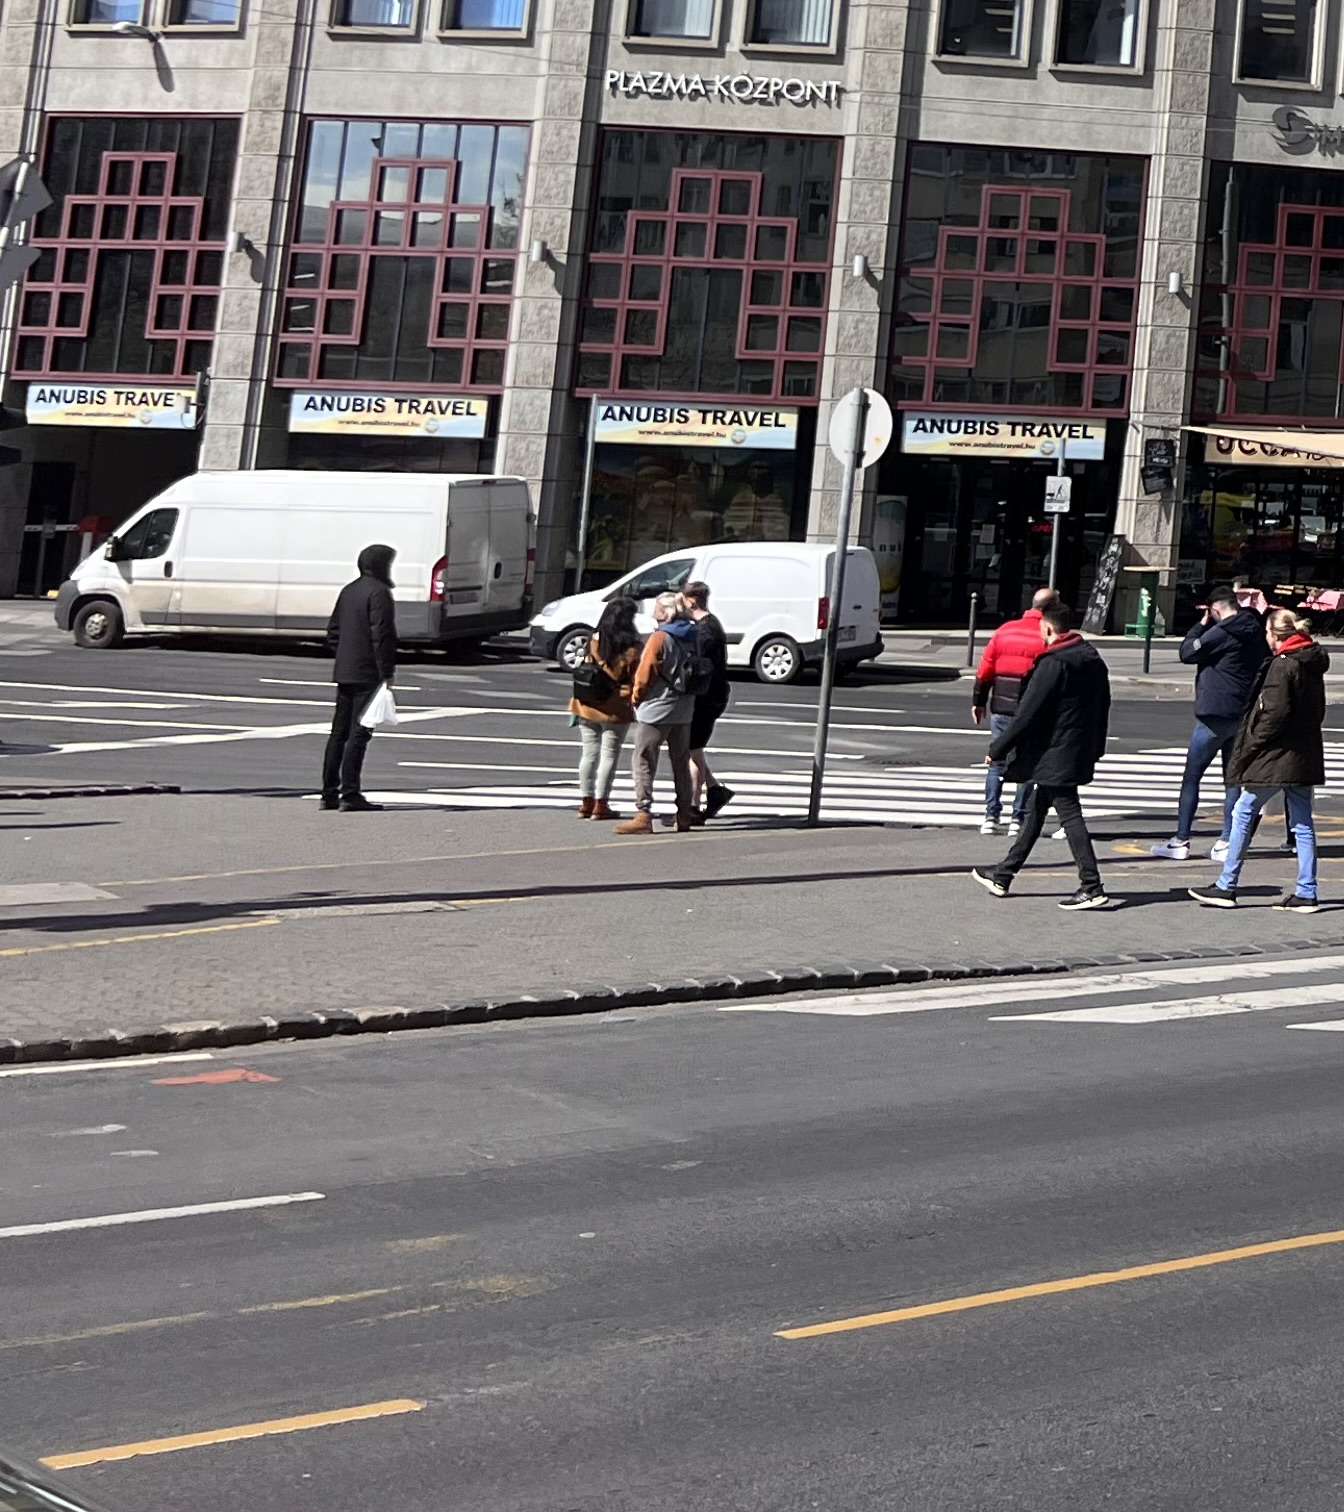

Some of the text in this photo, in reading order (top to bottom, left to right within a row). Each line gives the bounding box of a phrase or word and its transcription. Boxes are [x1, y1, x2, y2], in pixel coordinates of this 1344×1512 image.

[605, 70, 706, 96] PLAZMA
[35, 388, 183, 408] ANUBIS TRAVE
[303, 396, 478, 416] ANUBIS TRAVEL
[601, 405, 787, 428] ANUBIS TRAVEL
[912, 418, 1095, 440] ANUBIS TRAVEL
[949, 441, 1036, 450] www.anubistravel.hu
